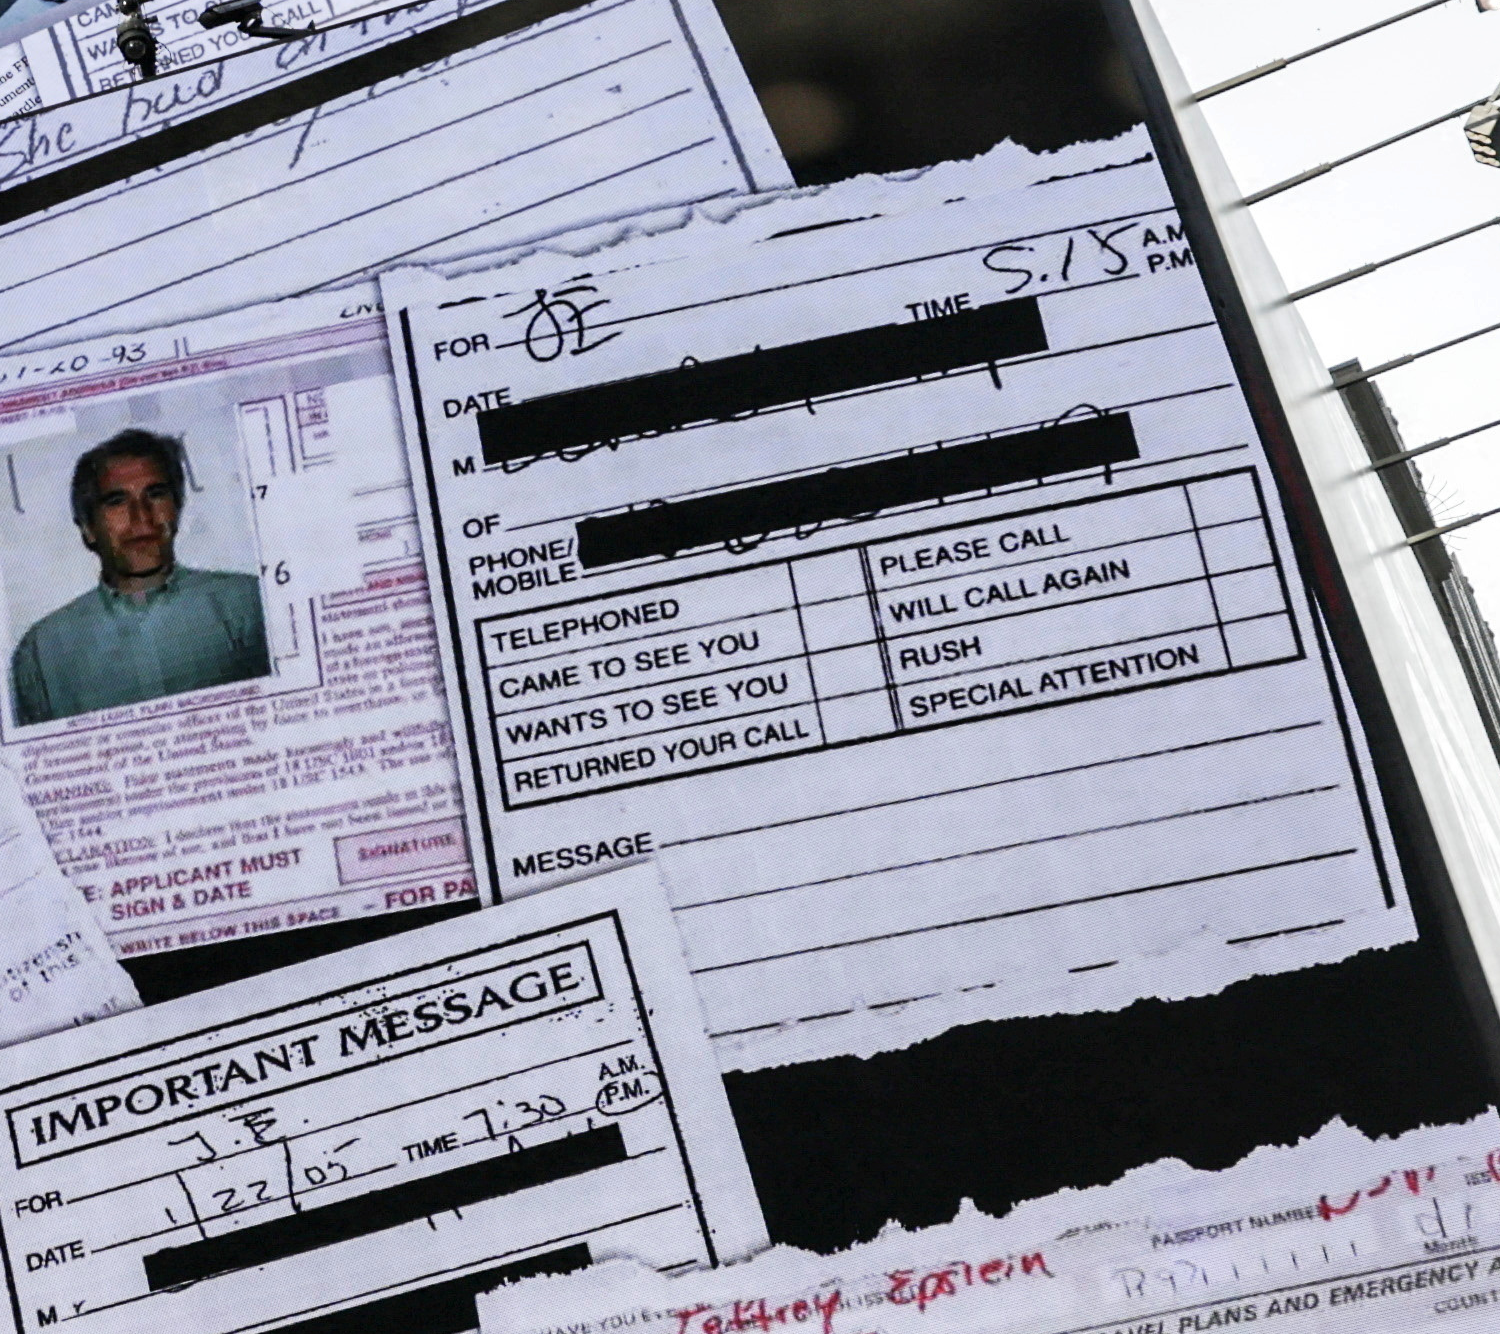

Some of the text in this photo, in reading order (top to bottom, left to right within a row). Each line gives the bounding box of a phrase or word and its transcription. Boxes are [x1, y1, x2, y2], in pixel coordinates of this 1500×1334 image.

[905, 293, 973, 323] TIME
[432, 332, 491, 363] FOR
[442, 388, 512, 419] DATE
[461, 515, 502, 540] OF
[468, 538, 575, 577] PHONE/
[879, 523, 1072, 576] PLEASE CALL
[471, 562, 578, 601] MOBILE
[889, 557, 1131, 623] WILL CALL AGAIN
[490, 599, 680, 654] TELEPHONED
[498, 628, 762, 700] CAME TO SEE YOU
[899, 635, 983, 670] RUSH
[908, 641, 1201, 719] SPECIAL ATTENTION
[505, 670, 790, 747] WANTS TO SEE YOU
[513, 717, 811, 793] RETURNED YOUR CALL
[108, 846, 305, 899] APPLICANT MUST
[511, 830, 655, 879] MESSAGE
[110, 879, 254, 922] SIGN & DATE
[382, 886, 434, 910] FOR
[30, 961, 581, 1148] IMPORTANT MESSAGE
[401, 1132, 460, 1163] TIME
[14, 1189, 65, 1218] FOR
[24, 1239, 87, 1272] DATE
[1265, 1291, 1322, 1319] AND
[1328, 1261, 1481, 1310] EMERGENCY
